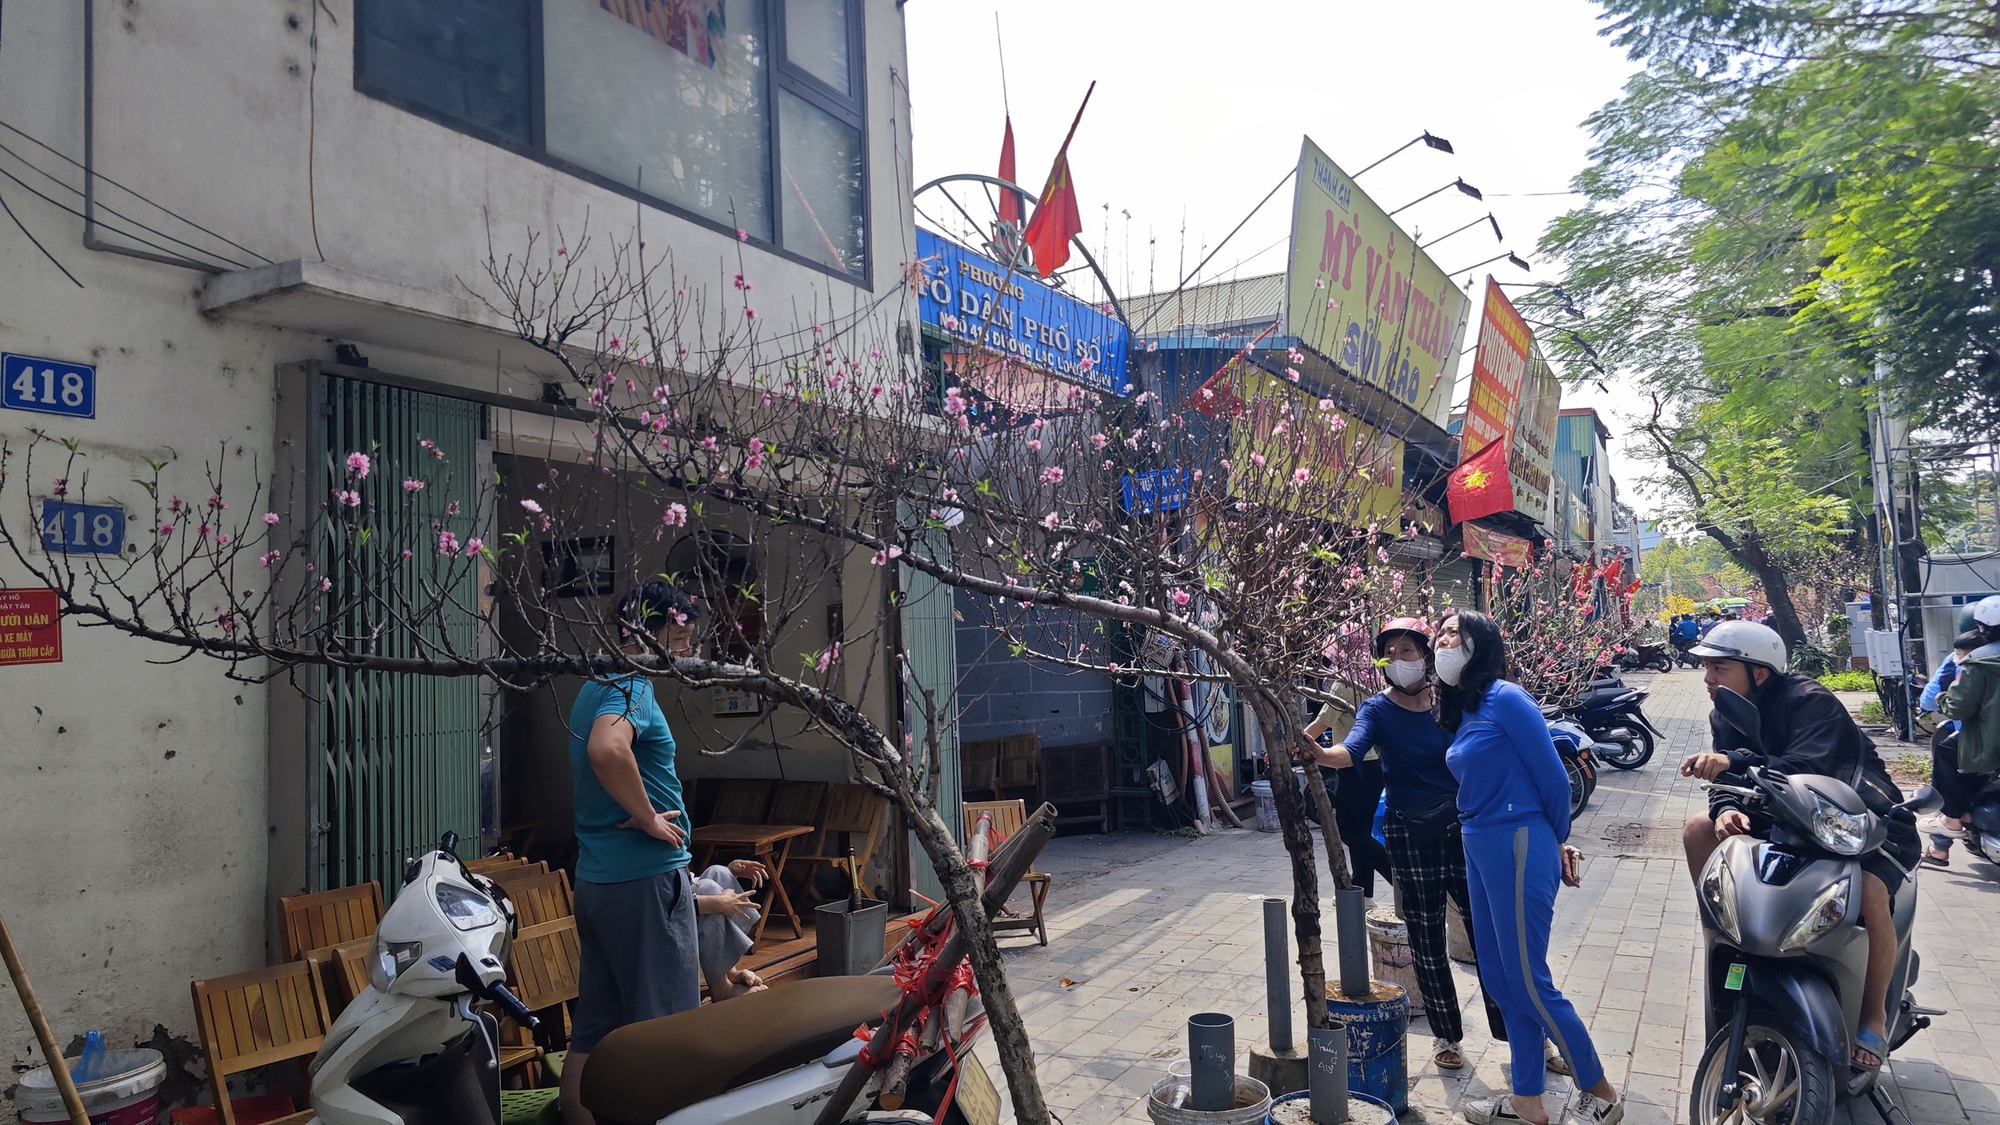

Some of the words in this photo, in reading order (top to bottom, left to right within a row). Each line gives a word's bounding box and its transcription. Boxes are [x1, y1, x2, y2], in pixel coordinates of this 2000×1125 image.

[1338, 183, 1351, 209] GIA
[1319, 208, 1362, 291] MỲ
[958, 260, 1025, 301] PHƯỜNG
[939, 311, 967, 334] NÕ
[961, 293, 1015, 330] DÂN
[1022, 315, 1070, 352] PHỐ
[1076, 334, 1102, 365] SỐ
[1385, 346, 1420, 404] CẢO
[1477, 315, 1526, 399] PHOTOCOPY
[12, 366, 84, 407] 418
[45, 510, 114, 547] 418
[0, 613, 21, 627] ƯỜI
[24, 612, 48, 626] DÂN
[4, 632, 14, 643] XE
[16, 630, 32, 643] MÁY
[0, 646, 16, 659] GỪA
[1318, 1060, 1334, 1074] 418
